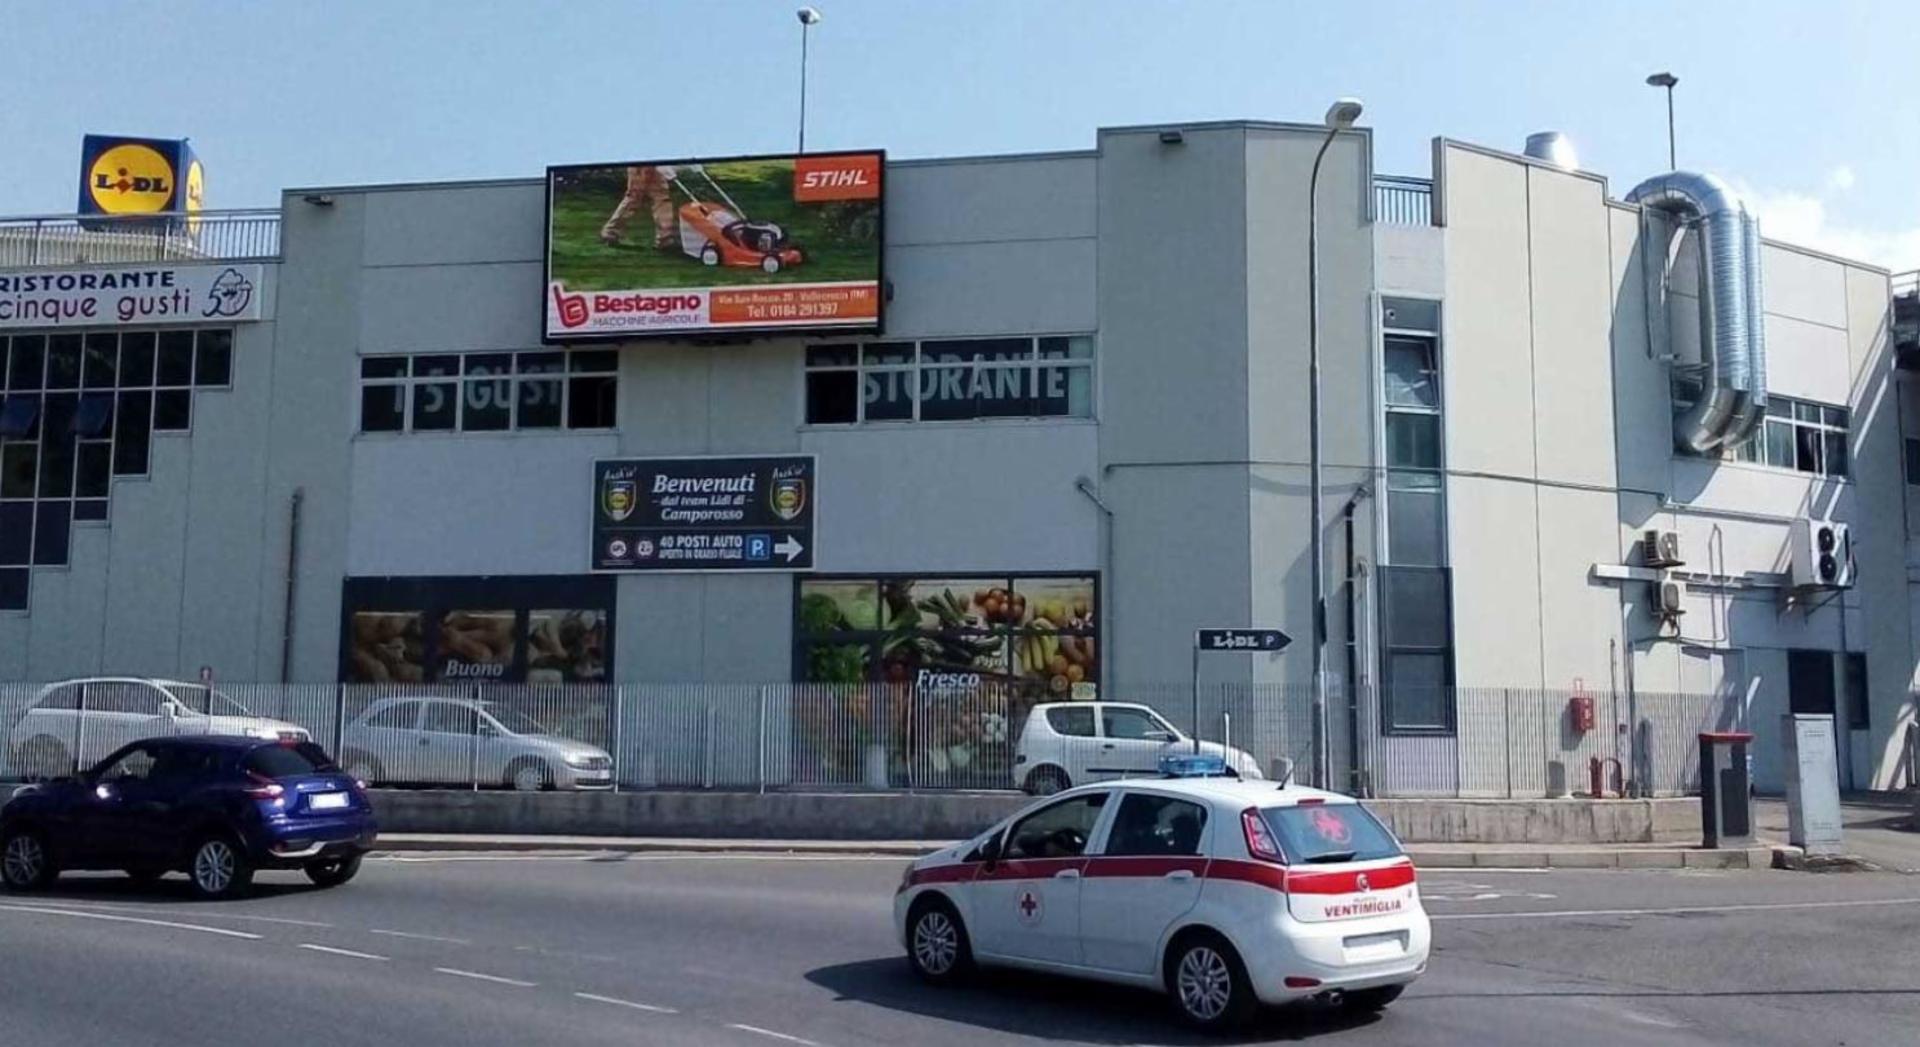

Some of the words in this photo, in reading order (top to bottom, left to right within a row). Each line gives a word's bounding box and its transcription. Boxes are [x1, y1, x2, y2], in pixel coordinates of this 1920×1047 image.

[803, 171, 868, 187] STIHL
[0, 271, 174, 292] RISTORANTE
[0, 295, 96, 323] cinque
[118, 289, 190, 321] gusti
[594, 294, 701, 314] Bestagno
[748, 306, 767, 317] Tel.
[770, 304, 796, 317] 0184
[799, 303, 838, 316] 291397
[652, 473, 756, 493] Benvenuti
[661, 495, 680, 506] dal
[681, 496, 708, 506] team
[710, 494, 731, 506] Lidl
[733, 494, 745, 505] di
[661, 508, 743, 524] Camporosso
[659, 535, 674, 548] 40
[677, 535, 709, 548] POSTI
[712, 535, 743, 548] AUTO
[1265, 635, 1275, 646] P
[446, 659, 504, 676] Buono
[916, 668, 980, 687] Fresco
[1324, 900, 1402, 918] VENTIMIGLIA
